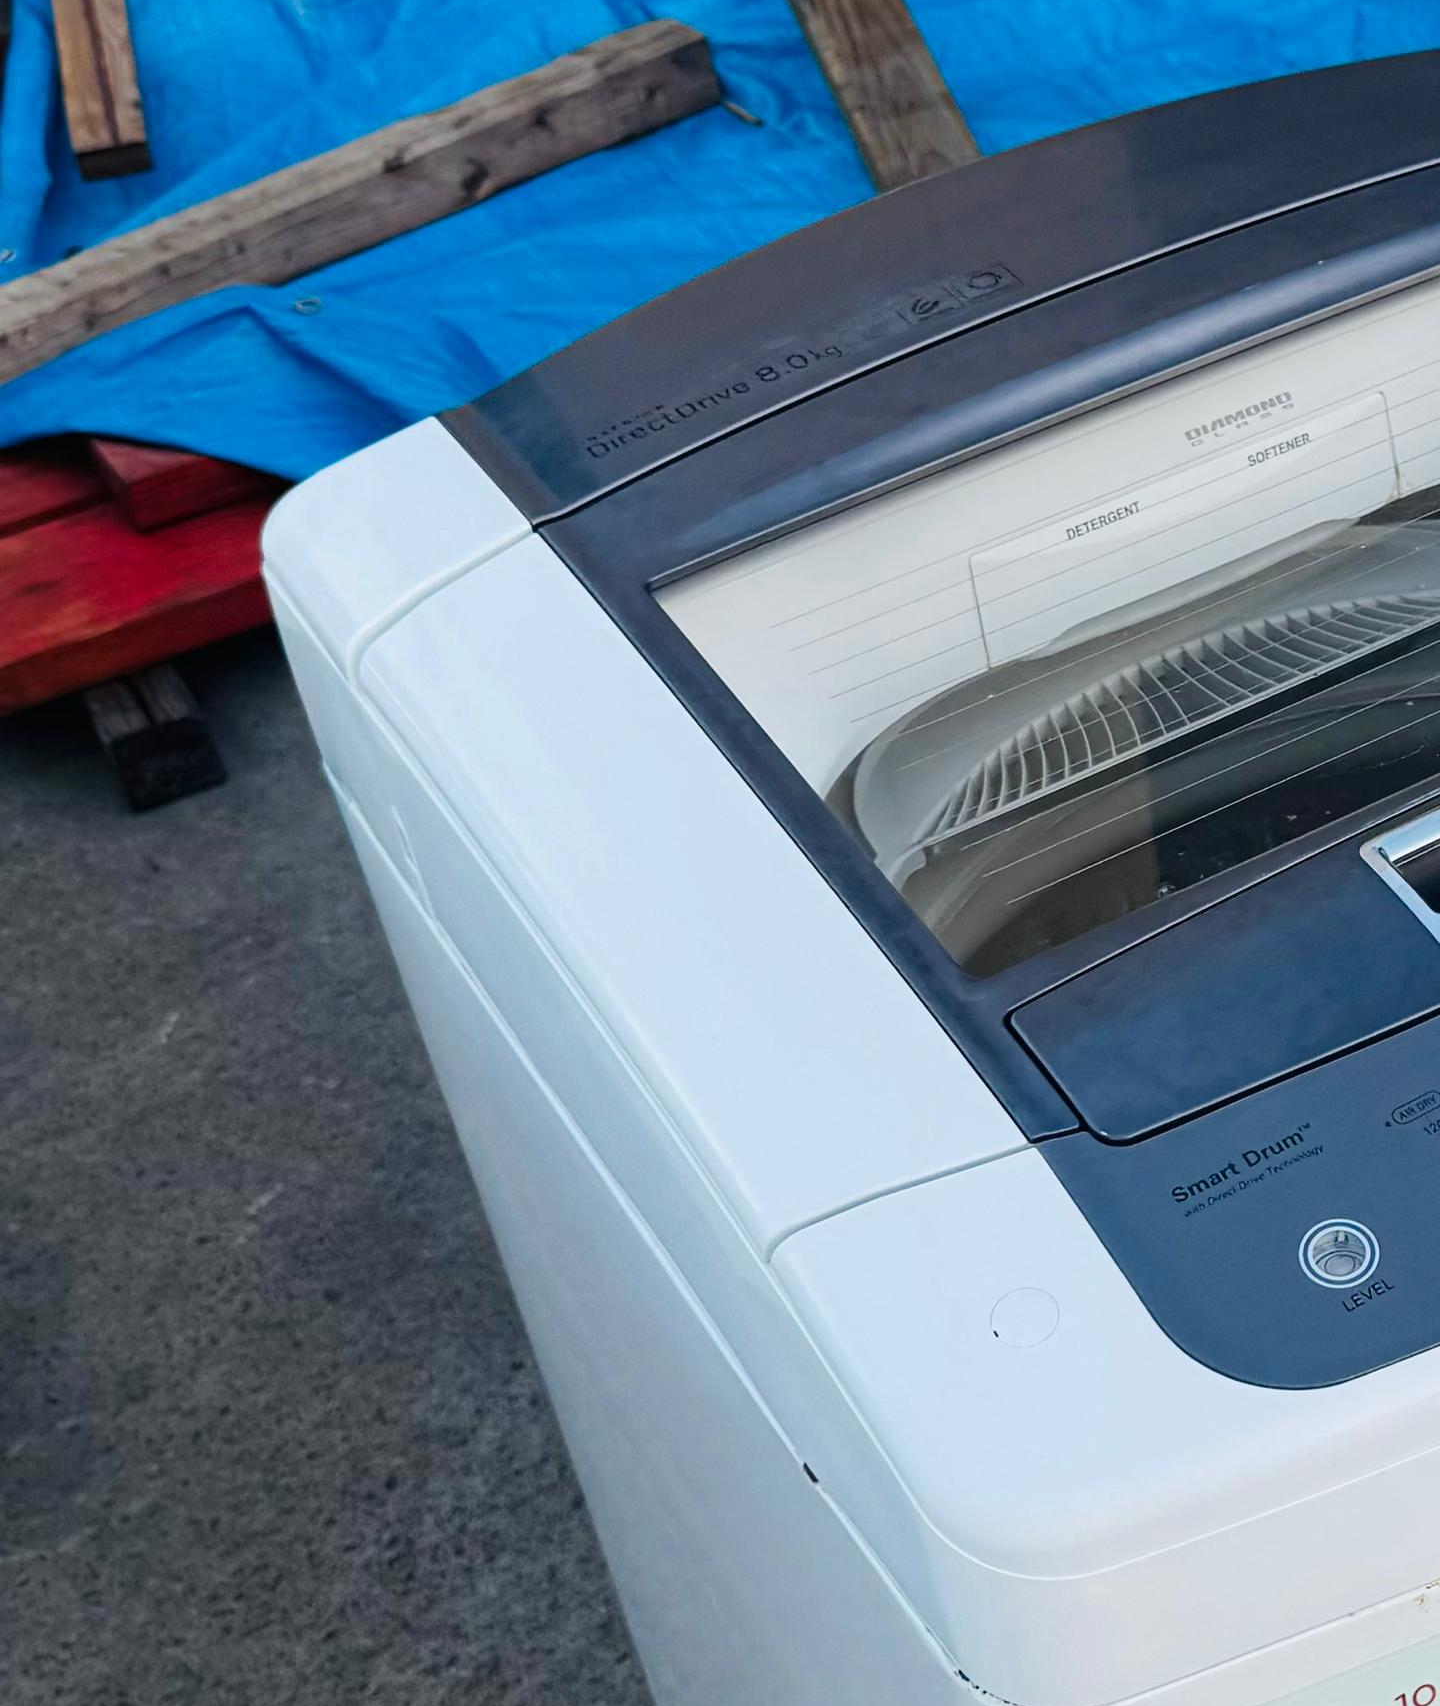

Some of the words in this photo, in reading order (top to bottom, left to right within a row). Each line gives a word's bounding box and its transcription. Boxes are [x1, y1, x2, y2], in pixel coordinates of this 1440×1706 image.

[1184, 391, 1293, 442] DIAMOND
[1247, 432, 1313, 467] SOFTENER
[1065, 501, 1140, 541] DETERGENT
[1399, 1105, 1416, 1122] AIR
[1416, 1094, 1438, 1111] DRY
[1171, 1161, 1241, 1204] Smart
[1341, 1279, 1394, 1312] LEVEL
